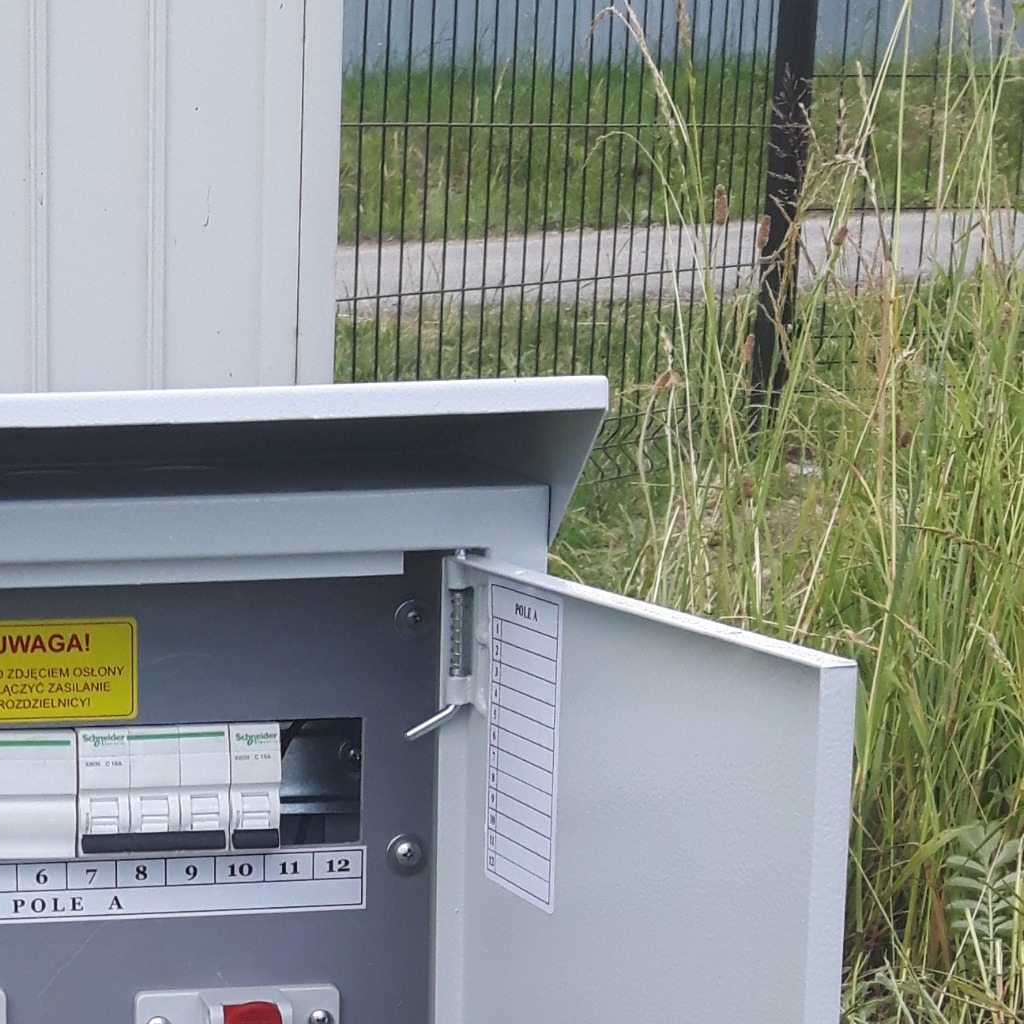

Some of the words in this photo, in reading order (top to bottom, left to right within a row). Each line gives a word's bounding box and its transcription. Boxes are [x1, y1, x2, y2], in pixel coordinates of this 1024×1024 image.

[515, 603, 532, 620] POLE
[533, 610, 538, 622] A
[7, 667, 70, 681] ZDJĘCIEM
[73, 666, 125, 677] OSŁONY
[48, 681, 111, 693] ZASILANIE
[82, 732, 125, 747] Schneider
[235, 732, 278, 746] Schneider
[36, 869, 48, 885] 6
[85, 869, 97, 884] 7
[135, 865, 148, 880] 8
[185, 865, 198, 880] 9
[227, 863, 253, 877] 10
[279, 861, 300, 875] 11
[326, 858, 350, 873] 12
[13, 896, 84, 914] POLE
[108, 895, 124, 910] A
